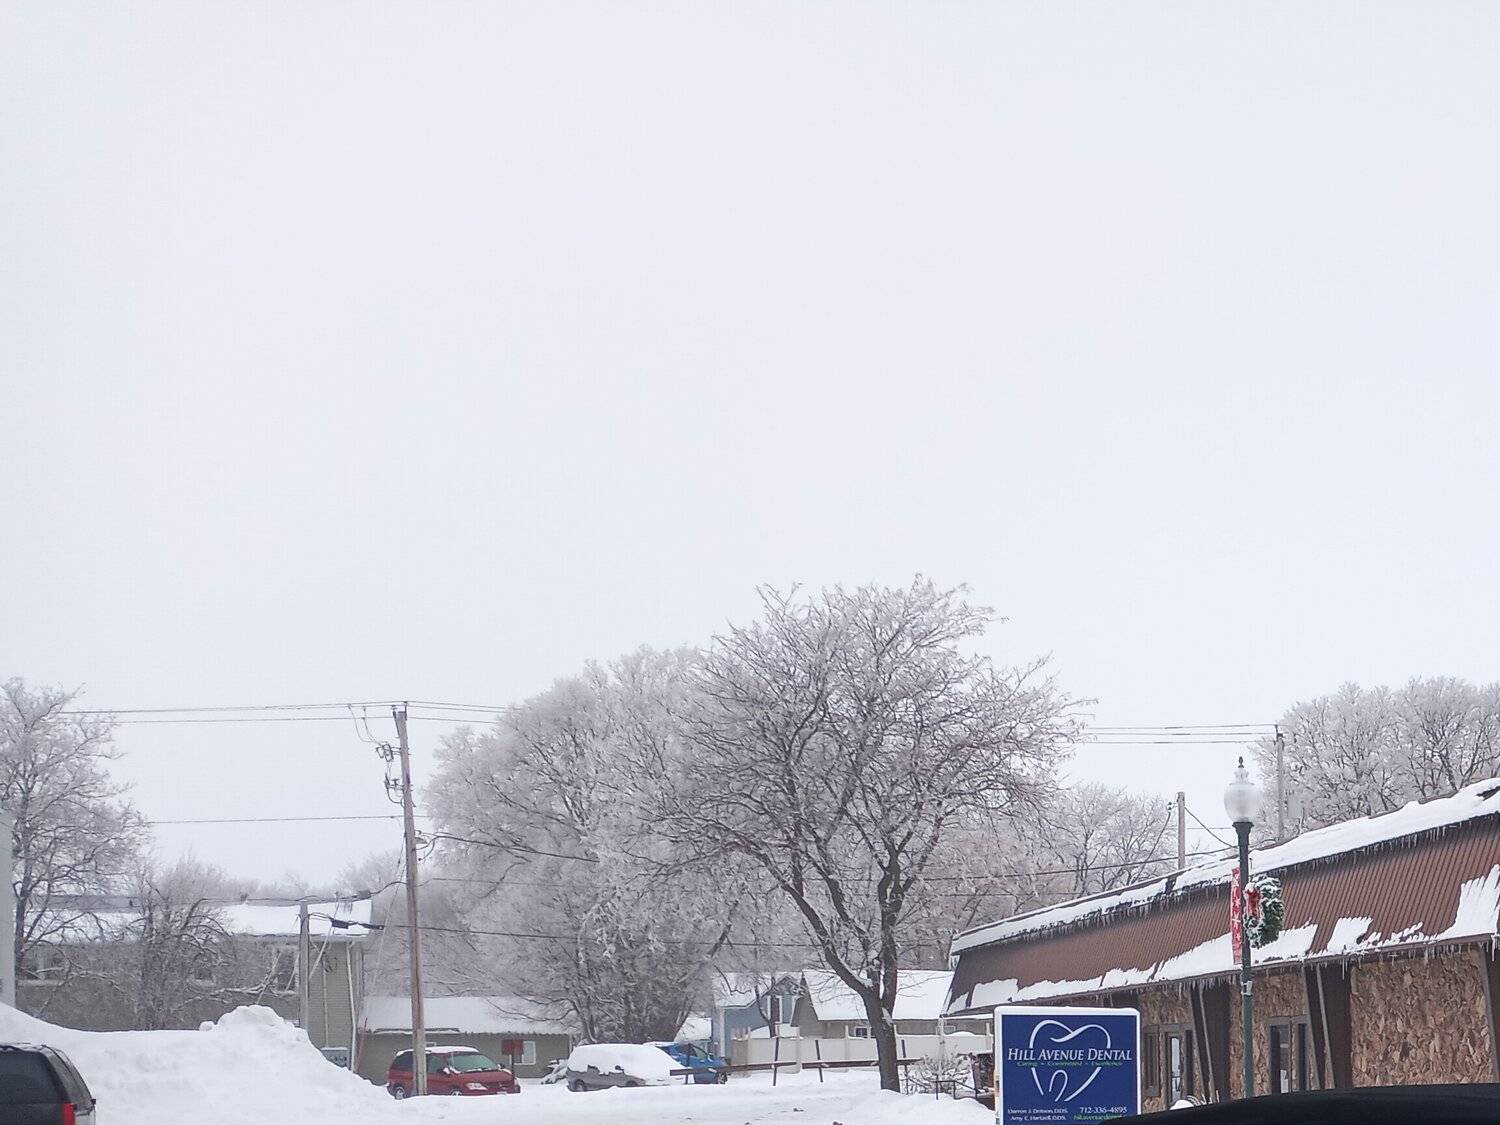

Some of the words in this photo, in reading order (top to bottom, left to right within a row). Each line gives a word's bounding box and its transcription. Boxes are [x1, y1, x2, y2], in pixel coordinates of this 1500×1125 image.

[1008, 1048, 1036, 1061] HILL
[1038, 1049, 1084, 1061] AVENUE
[1088, 1048, 1132, 1061] DENTAL
